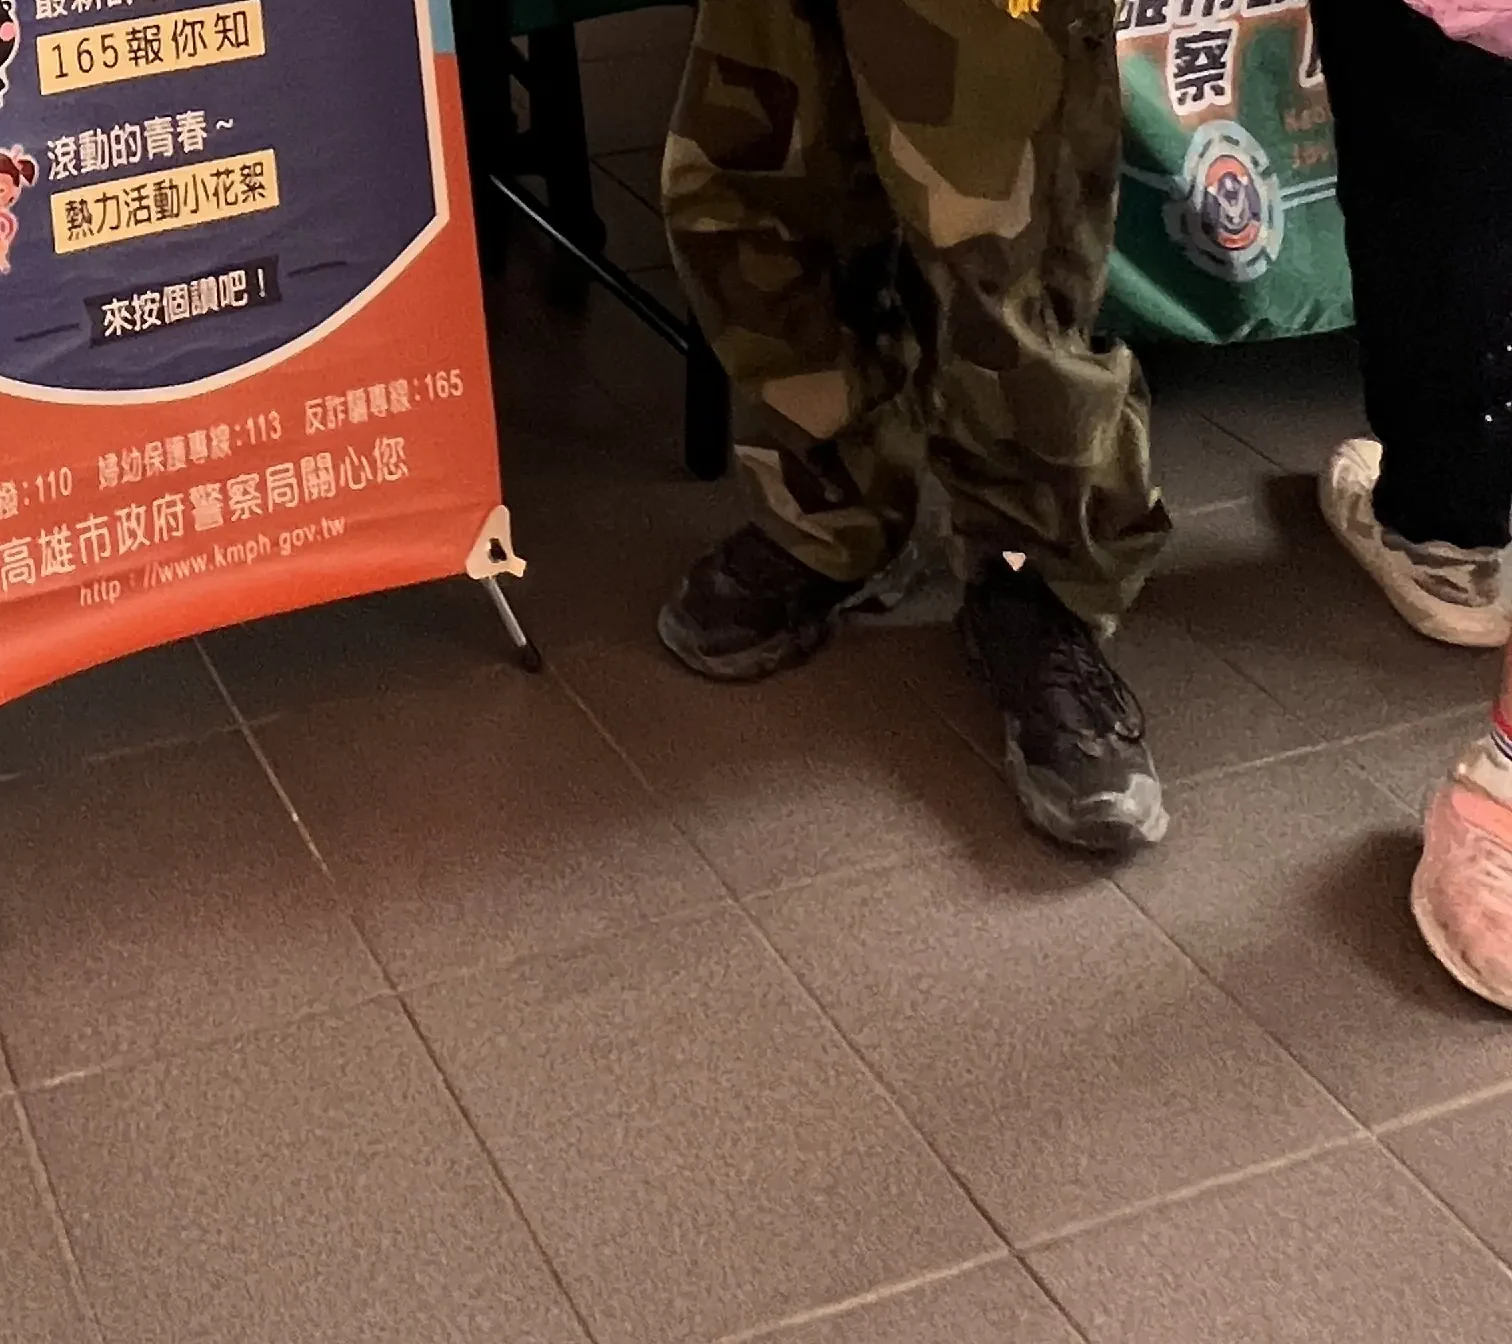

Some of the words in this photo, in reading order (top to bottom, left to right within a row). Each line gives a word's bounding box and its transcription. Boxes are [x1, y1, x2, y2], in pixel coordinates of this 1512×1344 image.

[51, 9, 250, 80] 165報你知
[64, 161, 268, 242] 熱力活動小花絮
[0, 435, 409, 592] 高雄市政府警察局關心您
